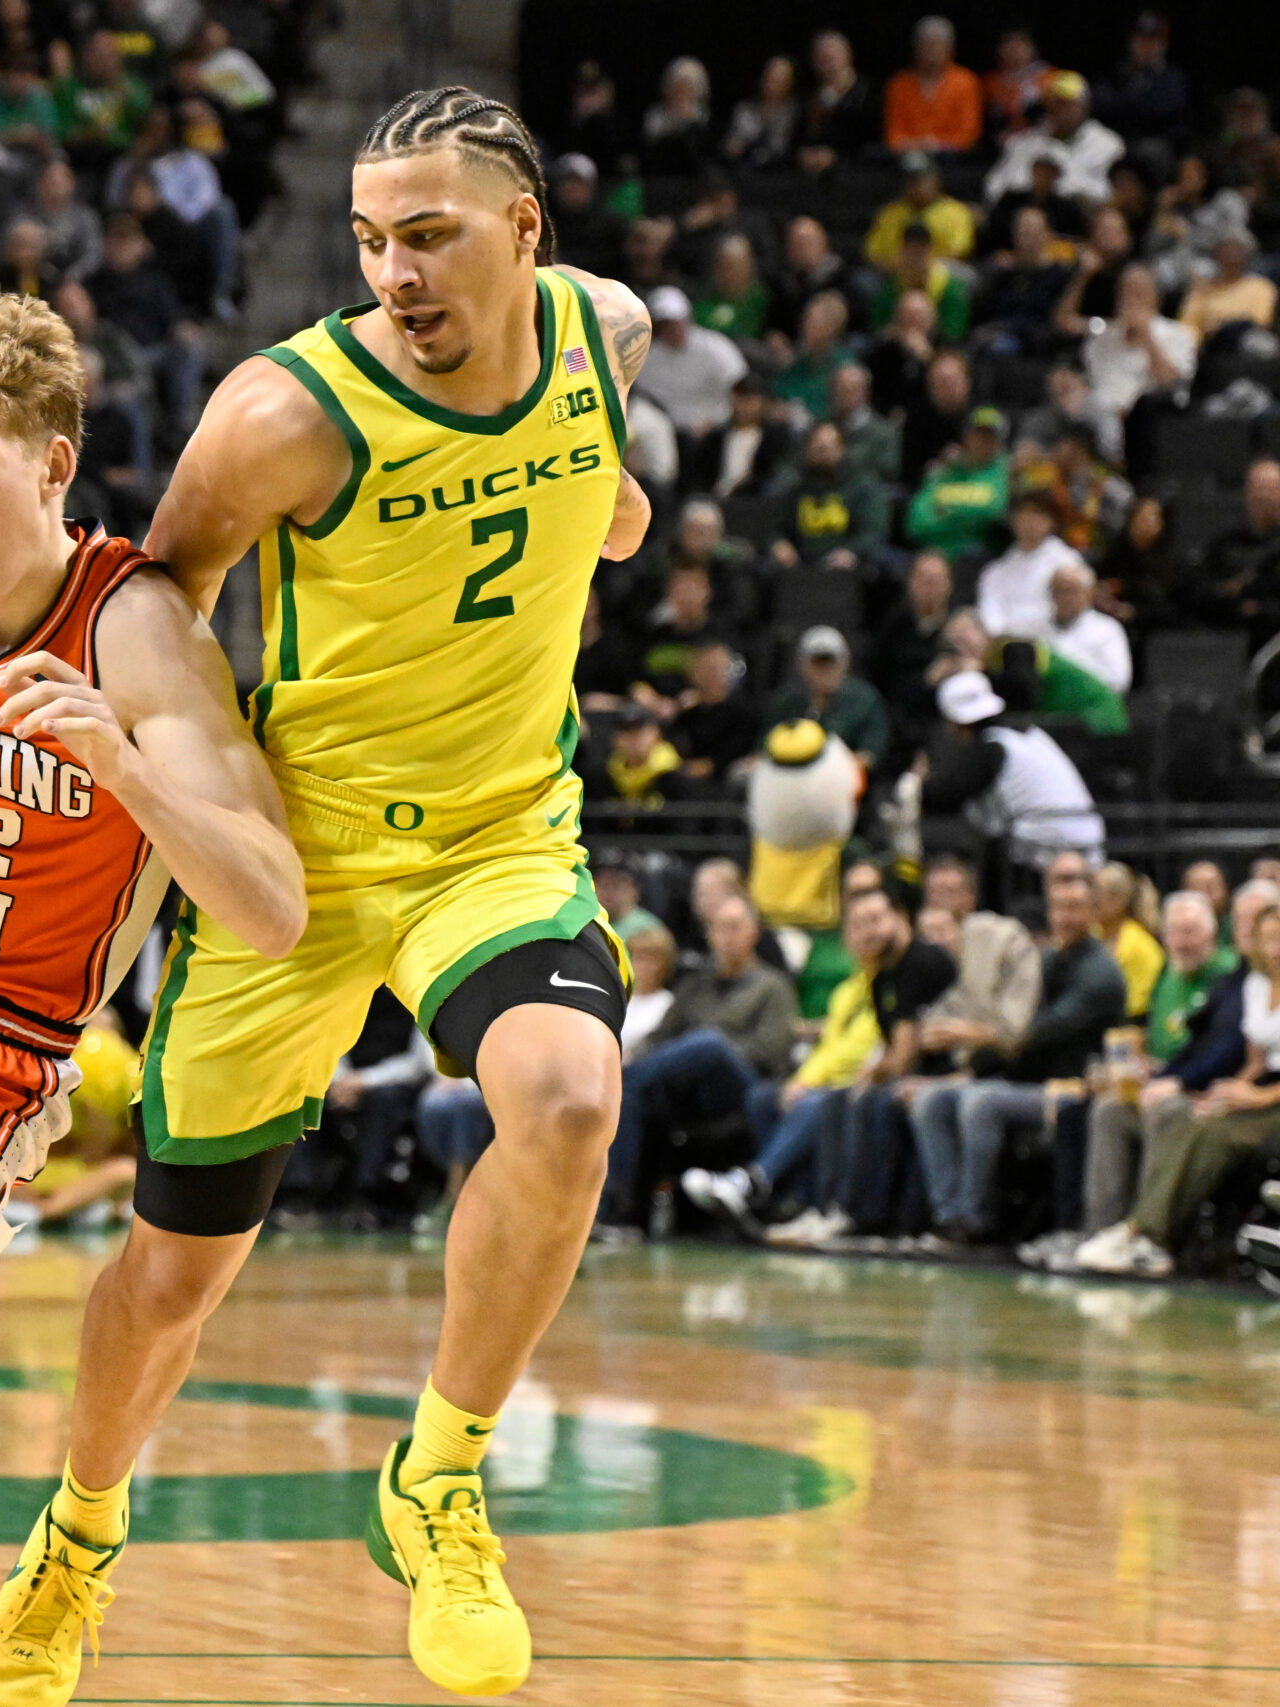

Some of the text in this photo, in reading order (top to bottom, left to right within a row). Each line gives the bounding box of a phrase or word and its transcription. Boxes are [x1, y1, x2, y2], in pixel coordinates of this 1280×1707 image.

[551, 387, 600, 424] BIG
[379, 444, 601, 523] DUCKS
[453, 507, 529, 624] 2
[384, 801, 425, 831] O
